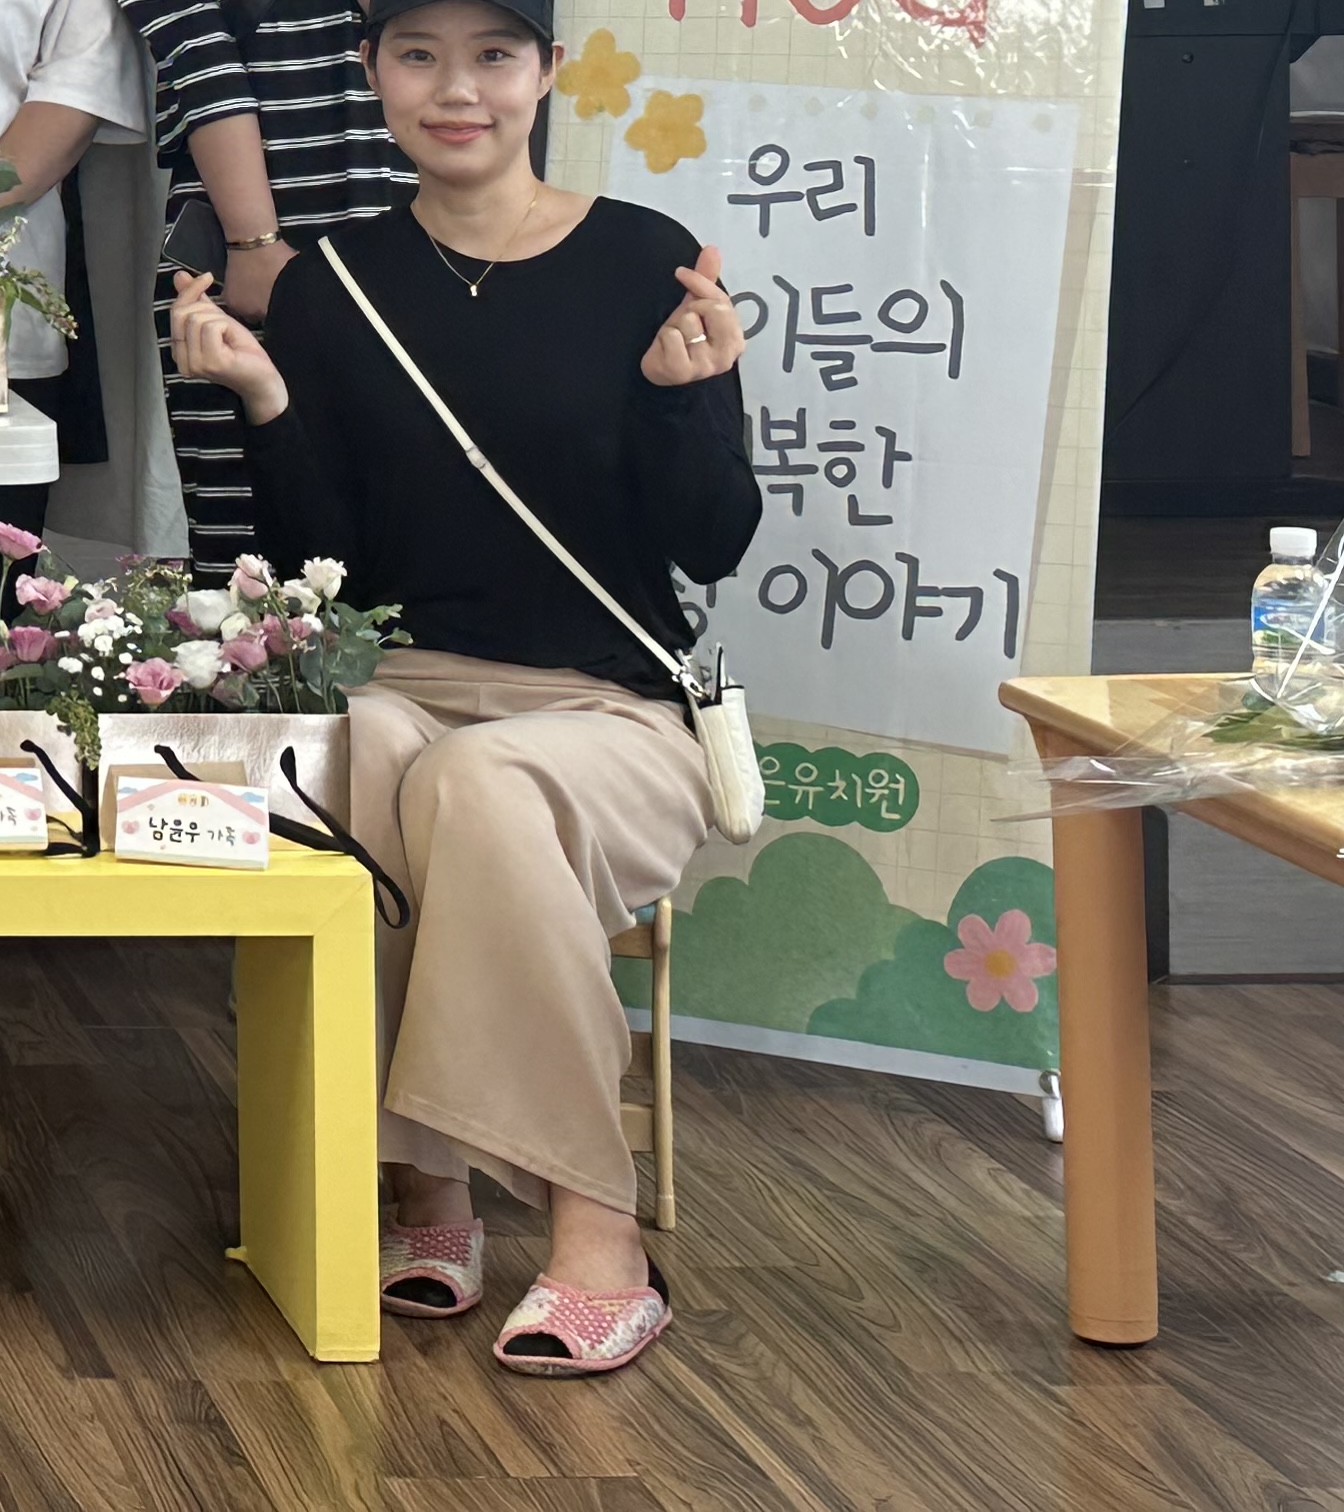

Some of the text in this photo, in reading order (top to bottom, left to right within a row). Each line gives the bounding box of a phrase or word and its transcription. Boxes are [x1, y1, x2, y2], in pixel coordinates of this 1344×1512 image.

[727, 143, 877, 238] 우리
[730, 274, 965, 392] 이들의
[743, 405, 913, 526] 복한
[758, 549, 1018, 659] 이야기
[759, 755, 906, 820] 은유치원
